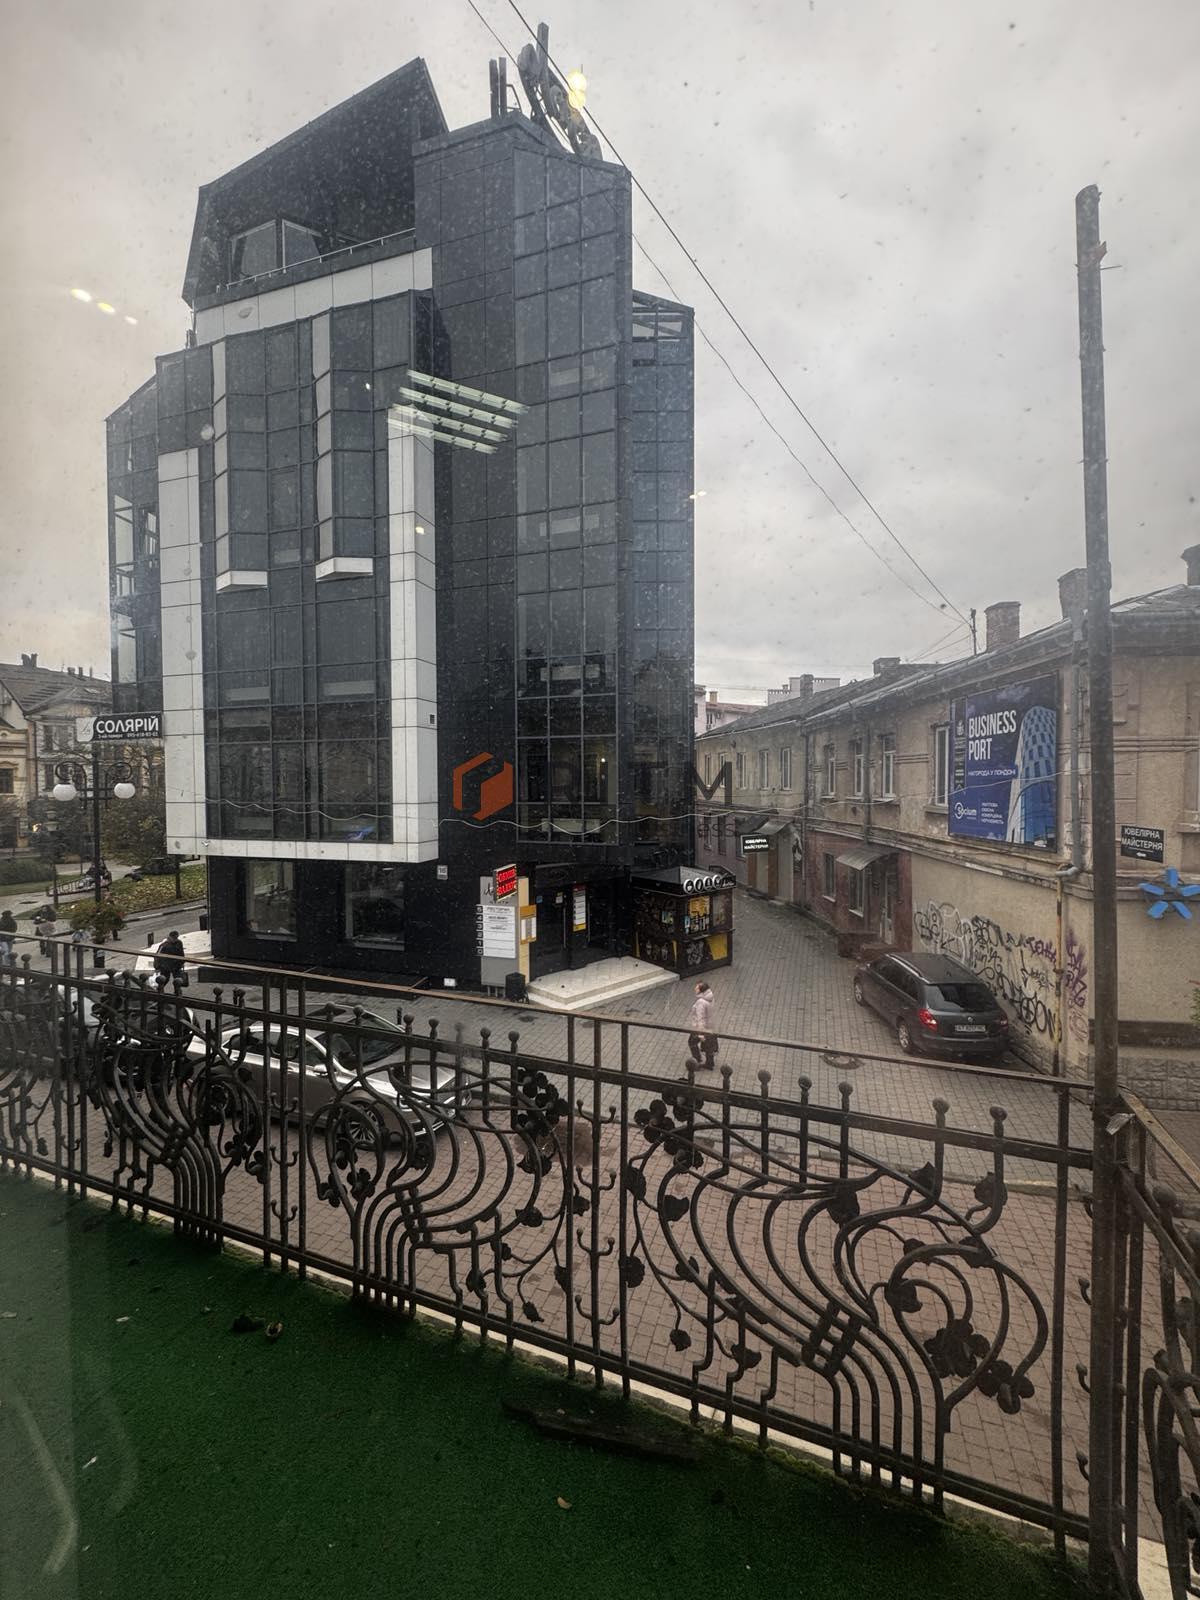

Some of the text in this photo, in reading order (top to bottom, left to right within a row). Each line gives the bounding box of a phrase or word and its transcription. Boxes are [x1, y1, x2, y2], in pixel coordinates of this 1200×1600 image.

[96, 716, 159, 733] СОЛЯРІЙ
[968, 709, 1017, 738] BUSINESS
[968, 738, 992, 761] PORT
[1124, 827, 1160, 839] ЮВЕЛІРНА
[1121, 837, 1163, 851] МАЙСТЕРНЯ
